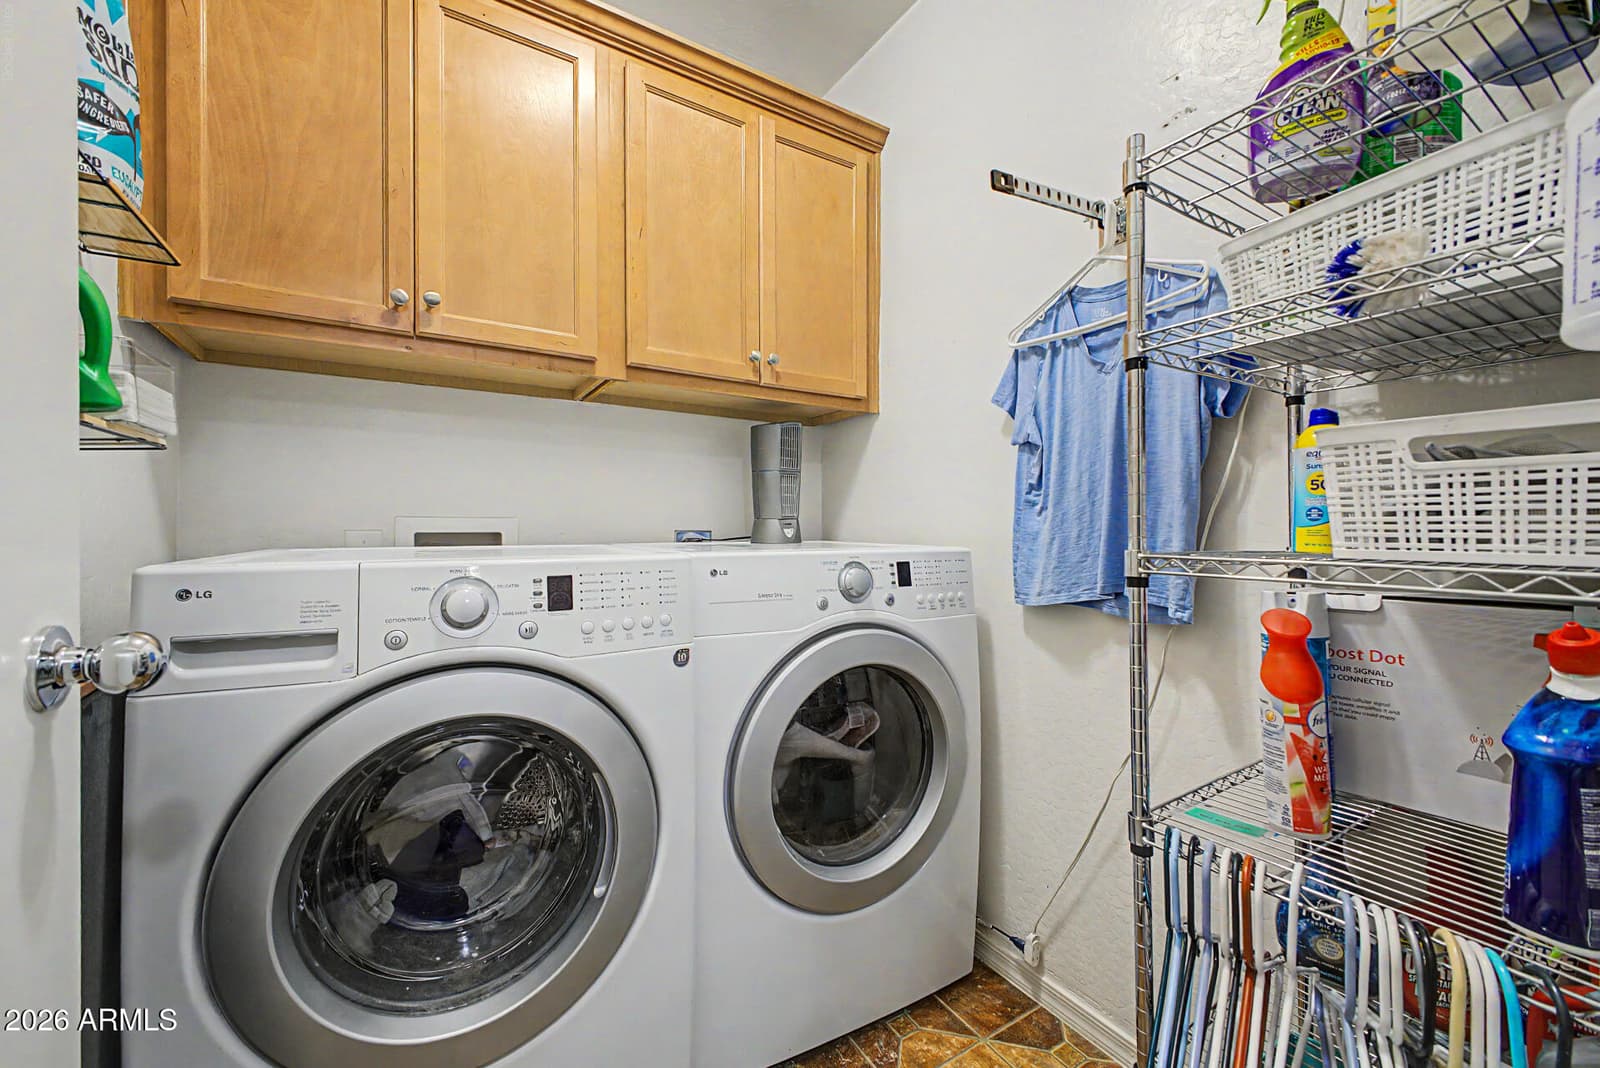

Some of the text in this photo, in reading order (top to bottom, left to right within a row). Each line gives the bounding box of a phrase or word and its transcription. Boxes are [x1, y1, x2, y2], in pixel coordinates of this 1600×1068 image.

[195, 590, 213, 599] LG
[1369, 649, 1405, 667] Dot
[1353, 666, 1388, 678] SIGNAL
[1337, 674, 1394, 688] CONNECTED
